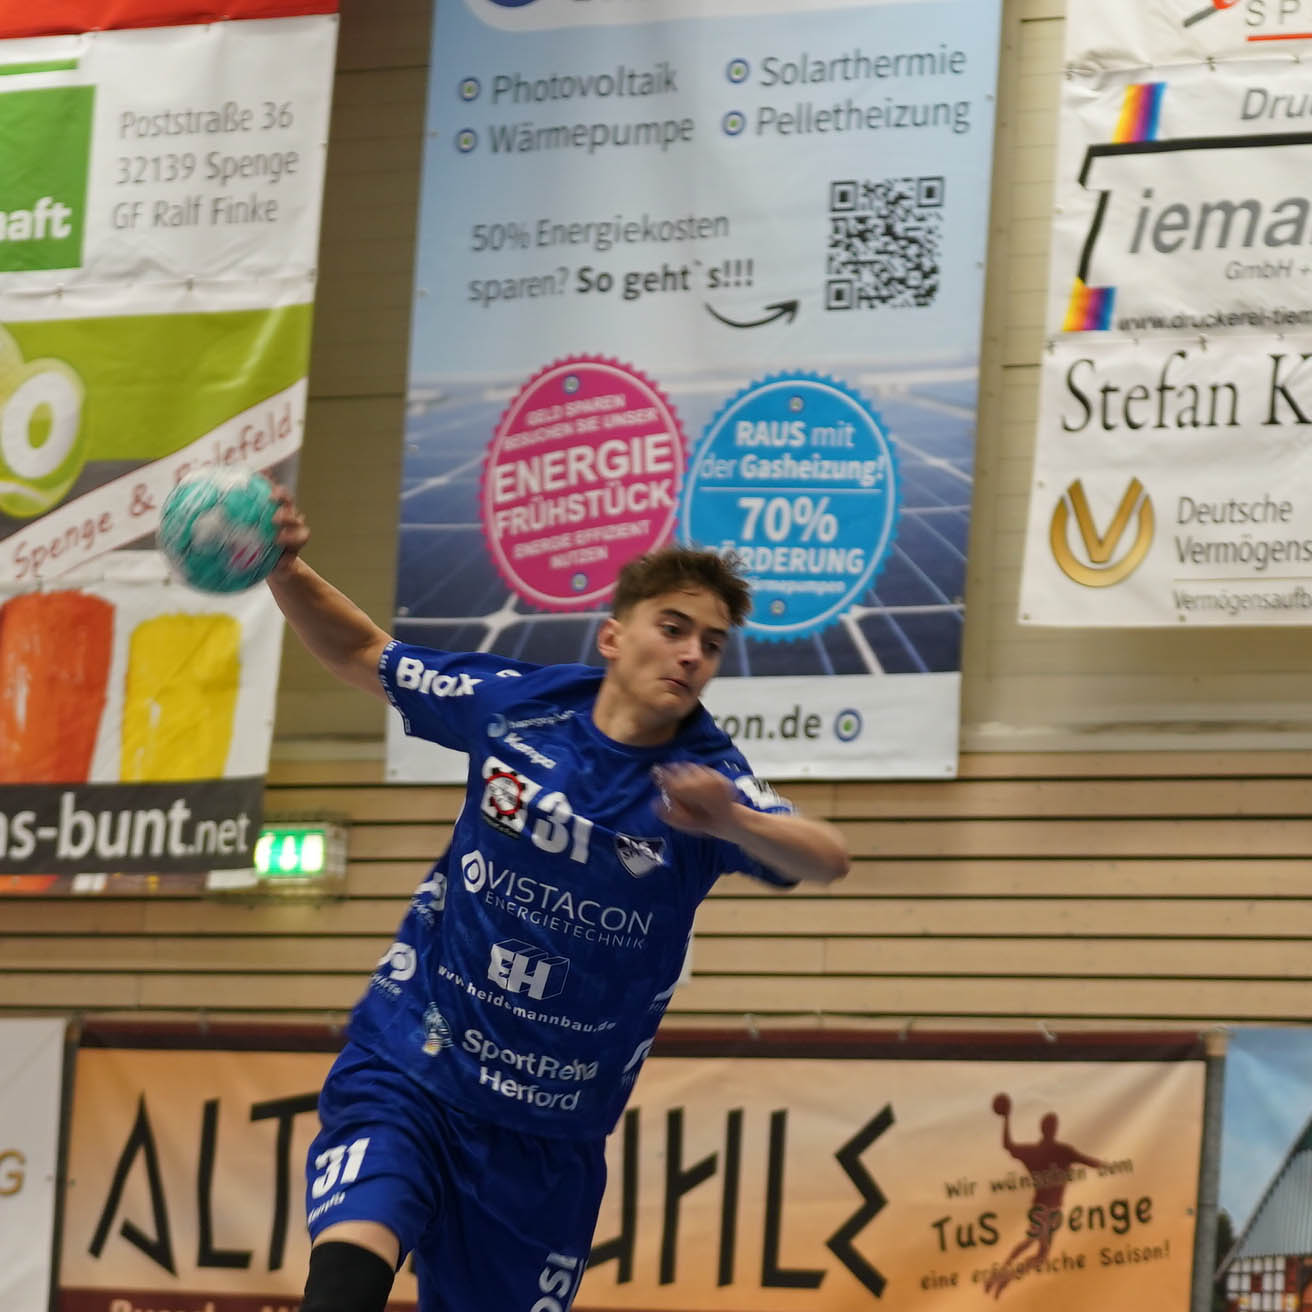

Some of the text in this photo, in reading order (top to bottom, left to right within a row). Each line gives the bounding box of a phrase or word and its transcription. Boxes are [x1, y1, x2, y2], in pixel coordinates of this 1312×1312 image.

[492, 64, 678, 104] Photovoltaik
[758, 44, 966, 89] Solarthermie
[119, 101, 294, 140] Poststraße 36
[489, 115, 696, 155] Wärmepumpe
[756, 97, 972, 138] Pelletheizung
[115, 148, 300, 187] 32139 Spenge
[112, 198, 279, 230] GF Ralf Finke
[471, 212, 730, 253] 50% Energiekosten
[468, 266, 570, 308] sparen?
[576, 267, 613, 294] So
[1224, 257, 1294, 281] GmbH
[1061, 351, 1240, 433] Stefan
[734, 420, 856, 448] RAUS mit
[494, 433, 674, 504] ENERGIE
[700, 452, 887, 489] der Gasheizung!
[494, 478, 675, 540] FRÜHSTÜCK
[736, 495, 839, 543] 70%
[1176, 495, 1293, 527] Deutsche
[13, 483, 156, 581] Spenge &
[396, 656, 485, 698] Brax
[531, 791, 595, 865] 31
[488, 860, 654, 937] VISTACON
[484, 890, 646, 950] ENERGIETECHNIK
[479, 1066, 582, 1112] Herford
[312, 1137, 370, 1199] 31
[930, 1195, 1154, 1252] TuS Spenge
[1098, 1239, 1171, 1268] Saison!
